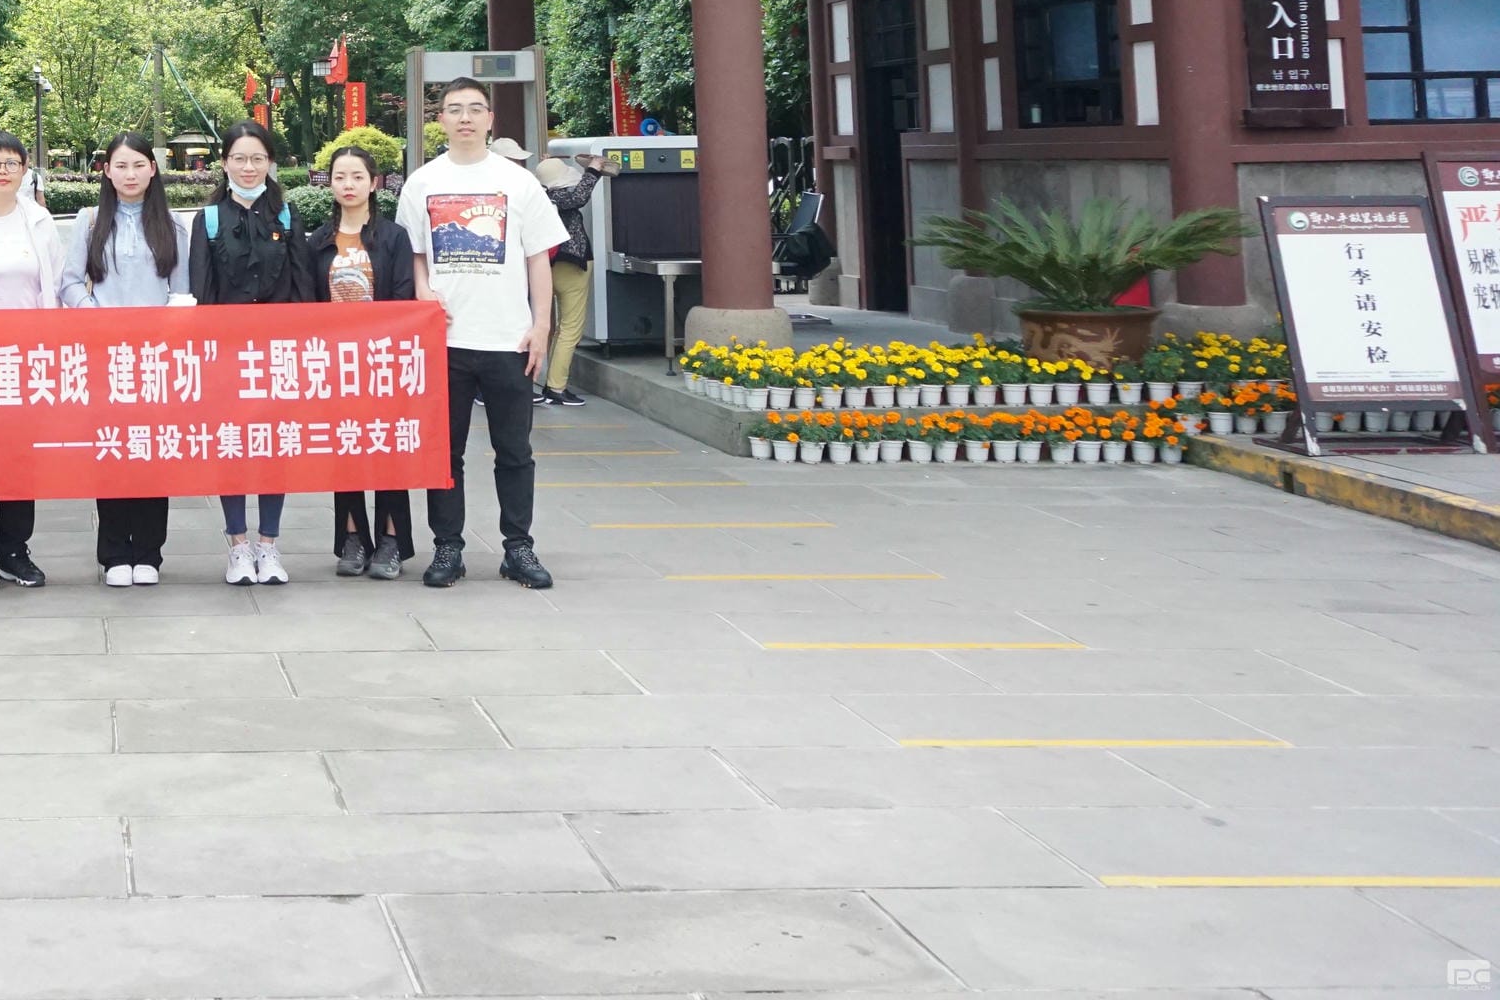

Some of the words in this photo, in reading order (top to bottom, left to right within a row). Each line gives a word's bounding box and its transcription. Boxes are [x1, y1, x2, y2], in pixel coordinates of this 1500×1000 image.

[1299, 13, 1311, 59] entrance
[1344, 242, 1390, 364] 行李请安检
[107, 340, 218, 404] 建新功”
[238, 335, 426, 400] 主题党日活动
